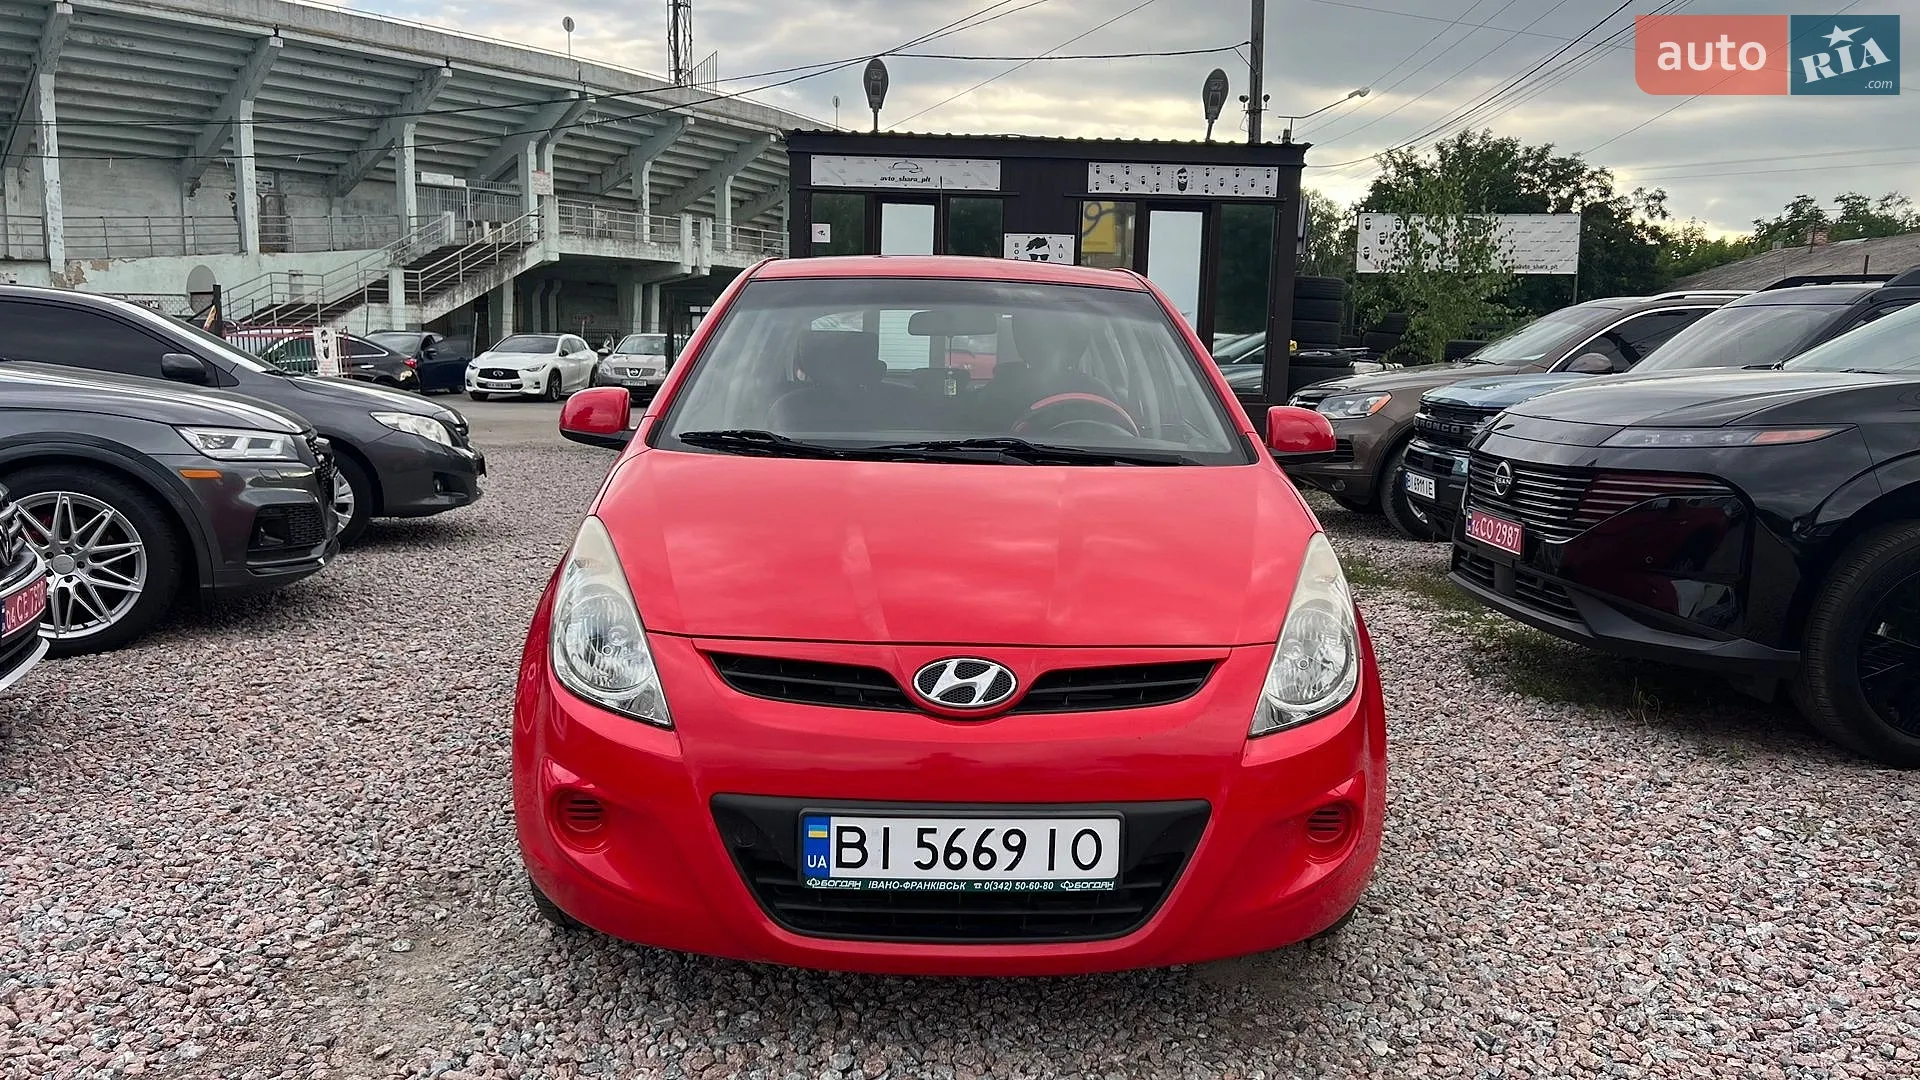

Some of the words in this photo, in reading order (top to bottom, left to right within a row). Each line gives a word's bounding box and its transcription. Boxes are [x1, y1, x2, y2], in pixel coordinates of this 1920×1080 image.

[1413, 418, 1461, 434] BRONCO
[1496, 522, 1520, 549] 2987
[807, 855, 827, 868] UA
[836, 826, 890, 870] BI
[914, 827, 1027, 871] 5669
[1048, 828, 1103, 871] IO
[868, 881, 967, 890] ІВАНО-ФРАНКІВСЬК
[984, 881, 1012, 890] 0(342)
[1014, 881, 1054, 890] 50-60-80
